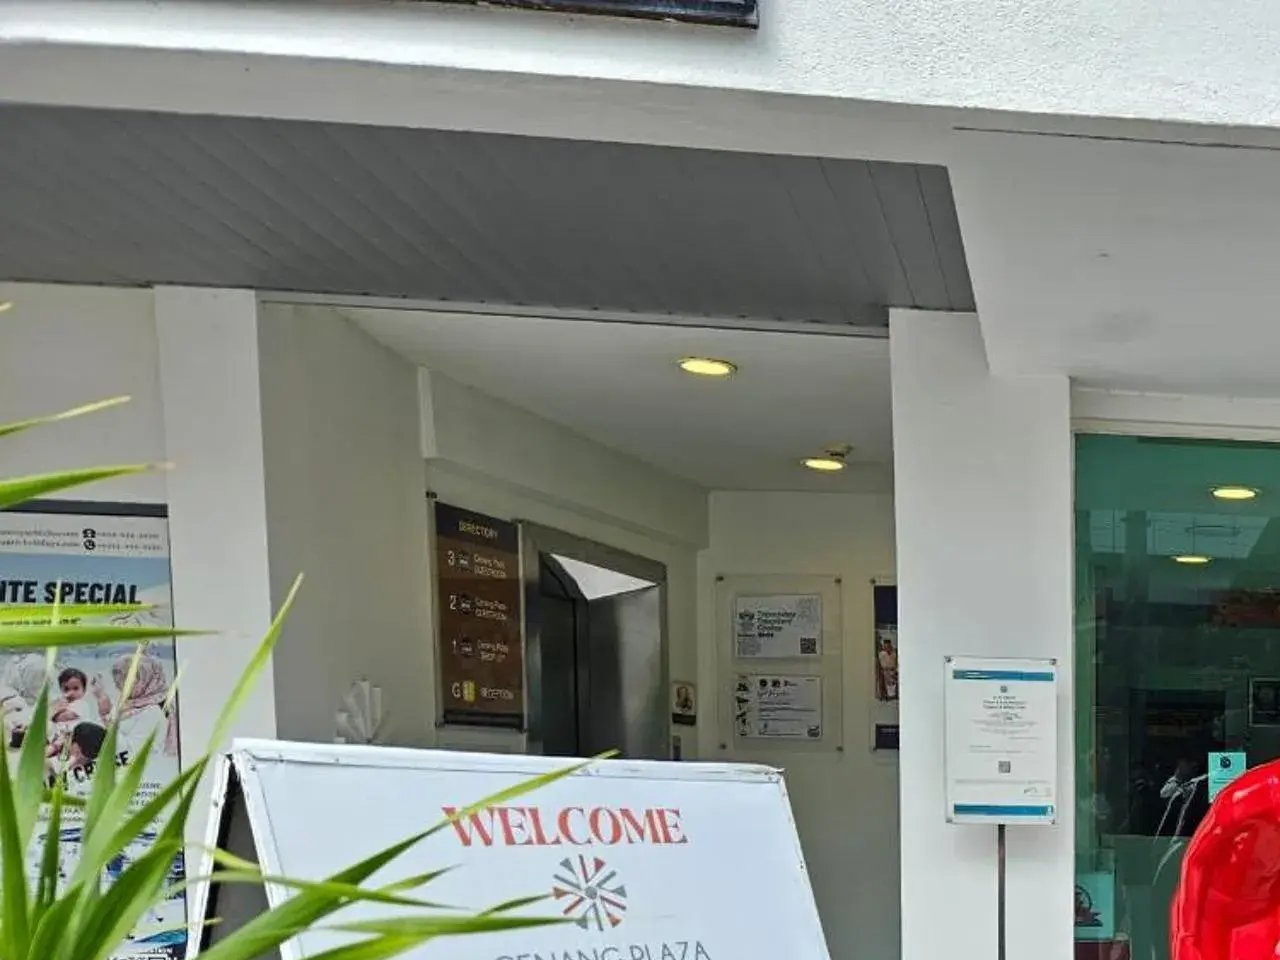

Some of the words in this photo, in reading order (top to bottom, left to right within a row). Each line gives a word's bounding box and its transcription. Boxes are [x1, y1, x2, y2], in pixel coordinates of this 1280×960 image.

[448, 550, 455, 566] 3
[44, 580, 142, 605] SPECIAL
[449, 594, 457, 611] 2
[452, 682, 461, 698] G
[442, 805, 689, 848] WELCOME
